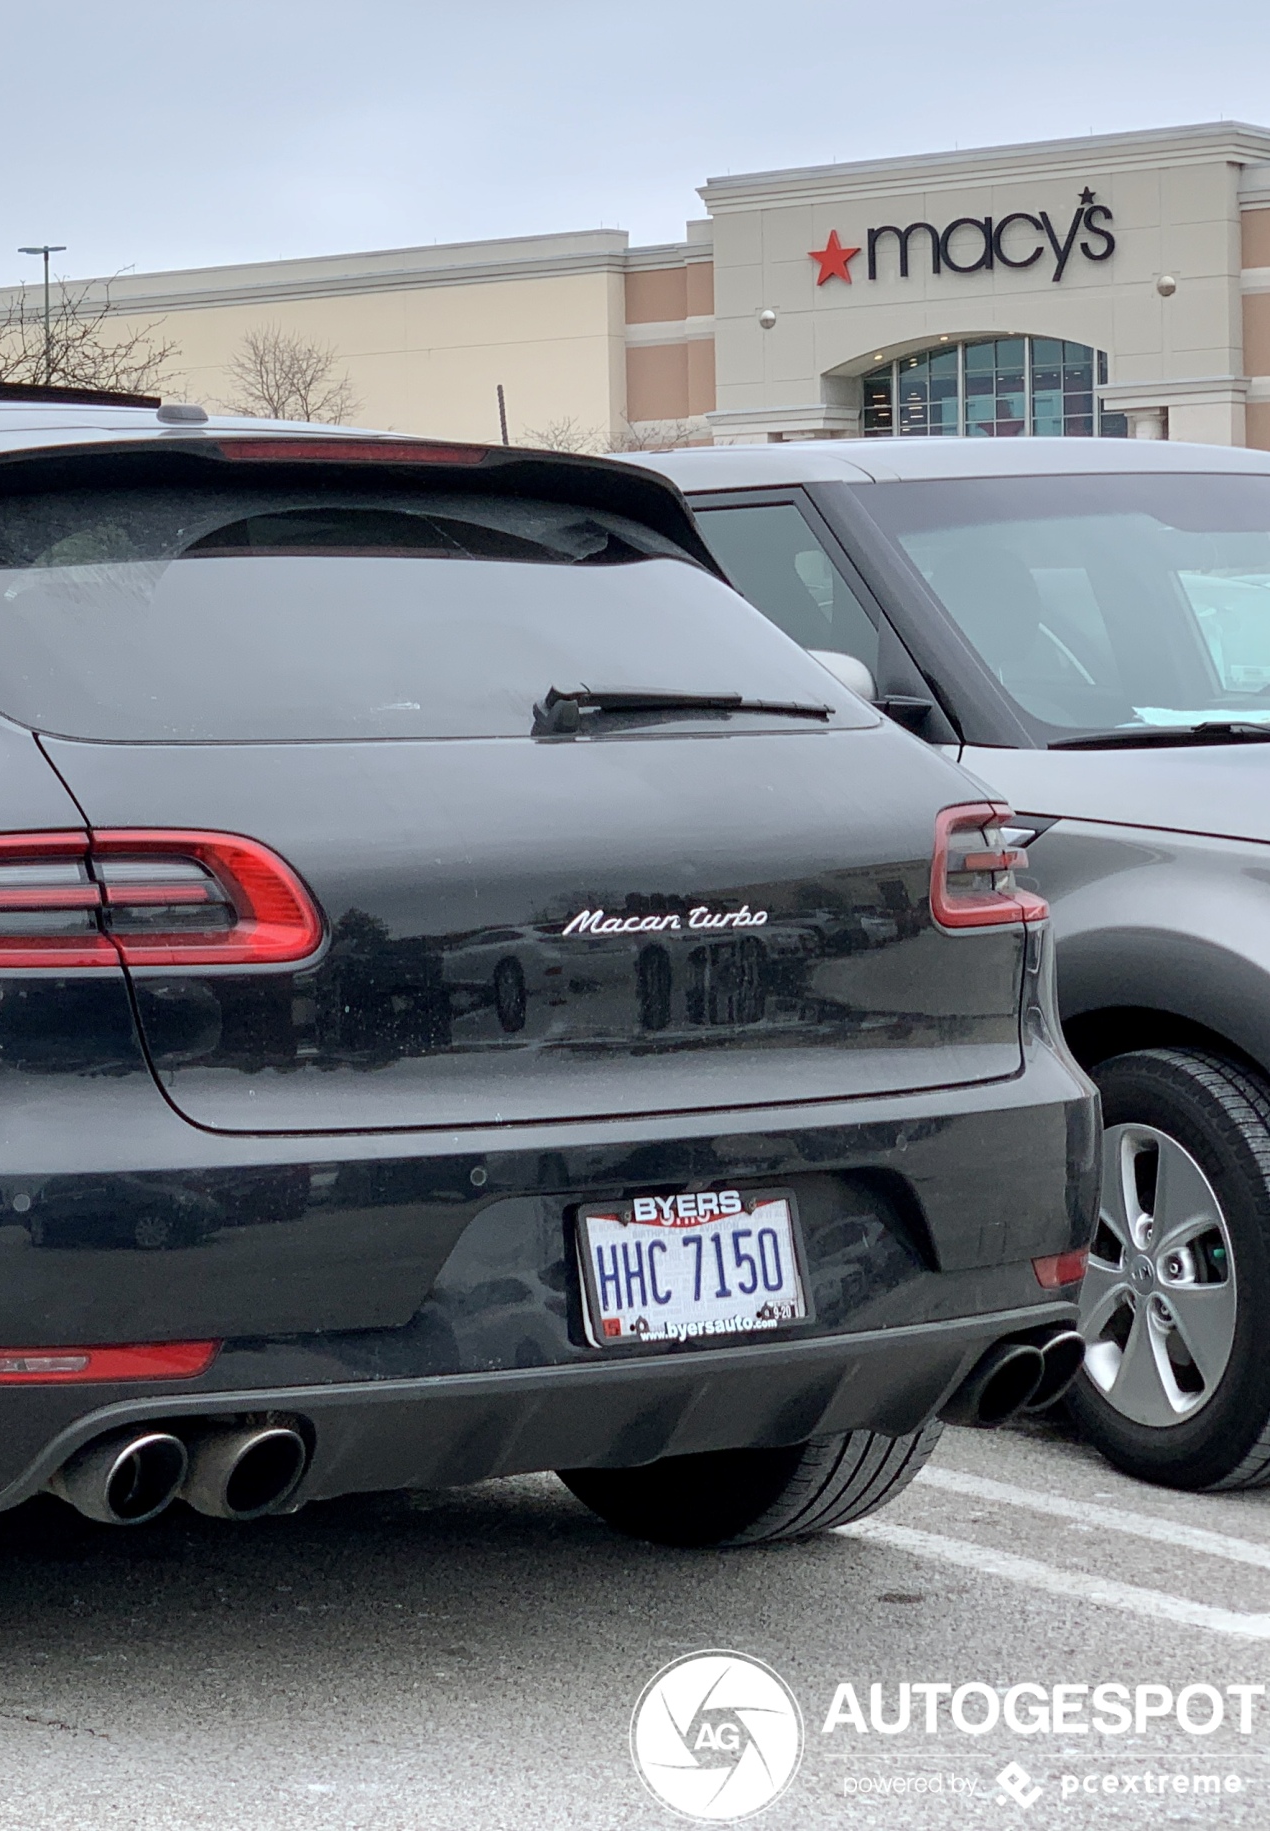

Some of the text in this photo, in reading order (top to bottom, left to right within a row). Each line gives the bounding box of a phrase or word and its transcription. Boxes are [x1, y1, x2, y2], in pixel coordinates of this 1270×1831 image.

[562, 905, 769, 936] Macan turbo
[633, 1190, 743, 1223] BYERS
[596, 1227, 784, 1312] HHC 7150
[640, 1314, 778, 1342] www.byersauto.com
